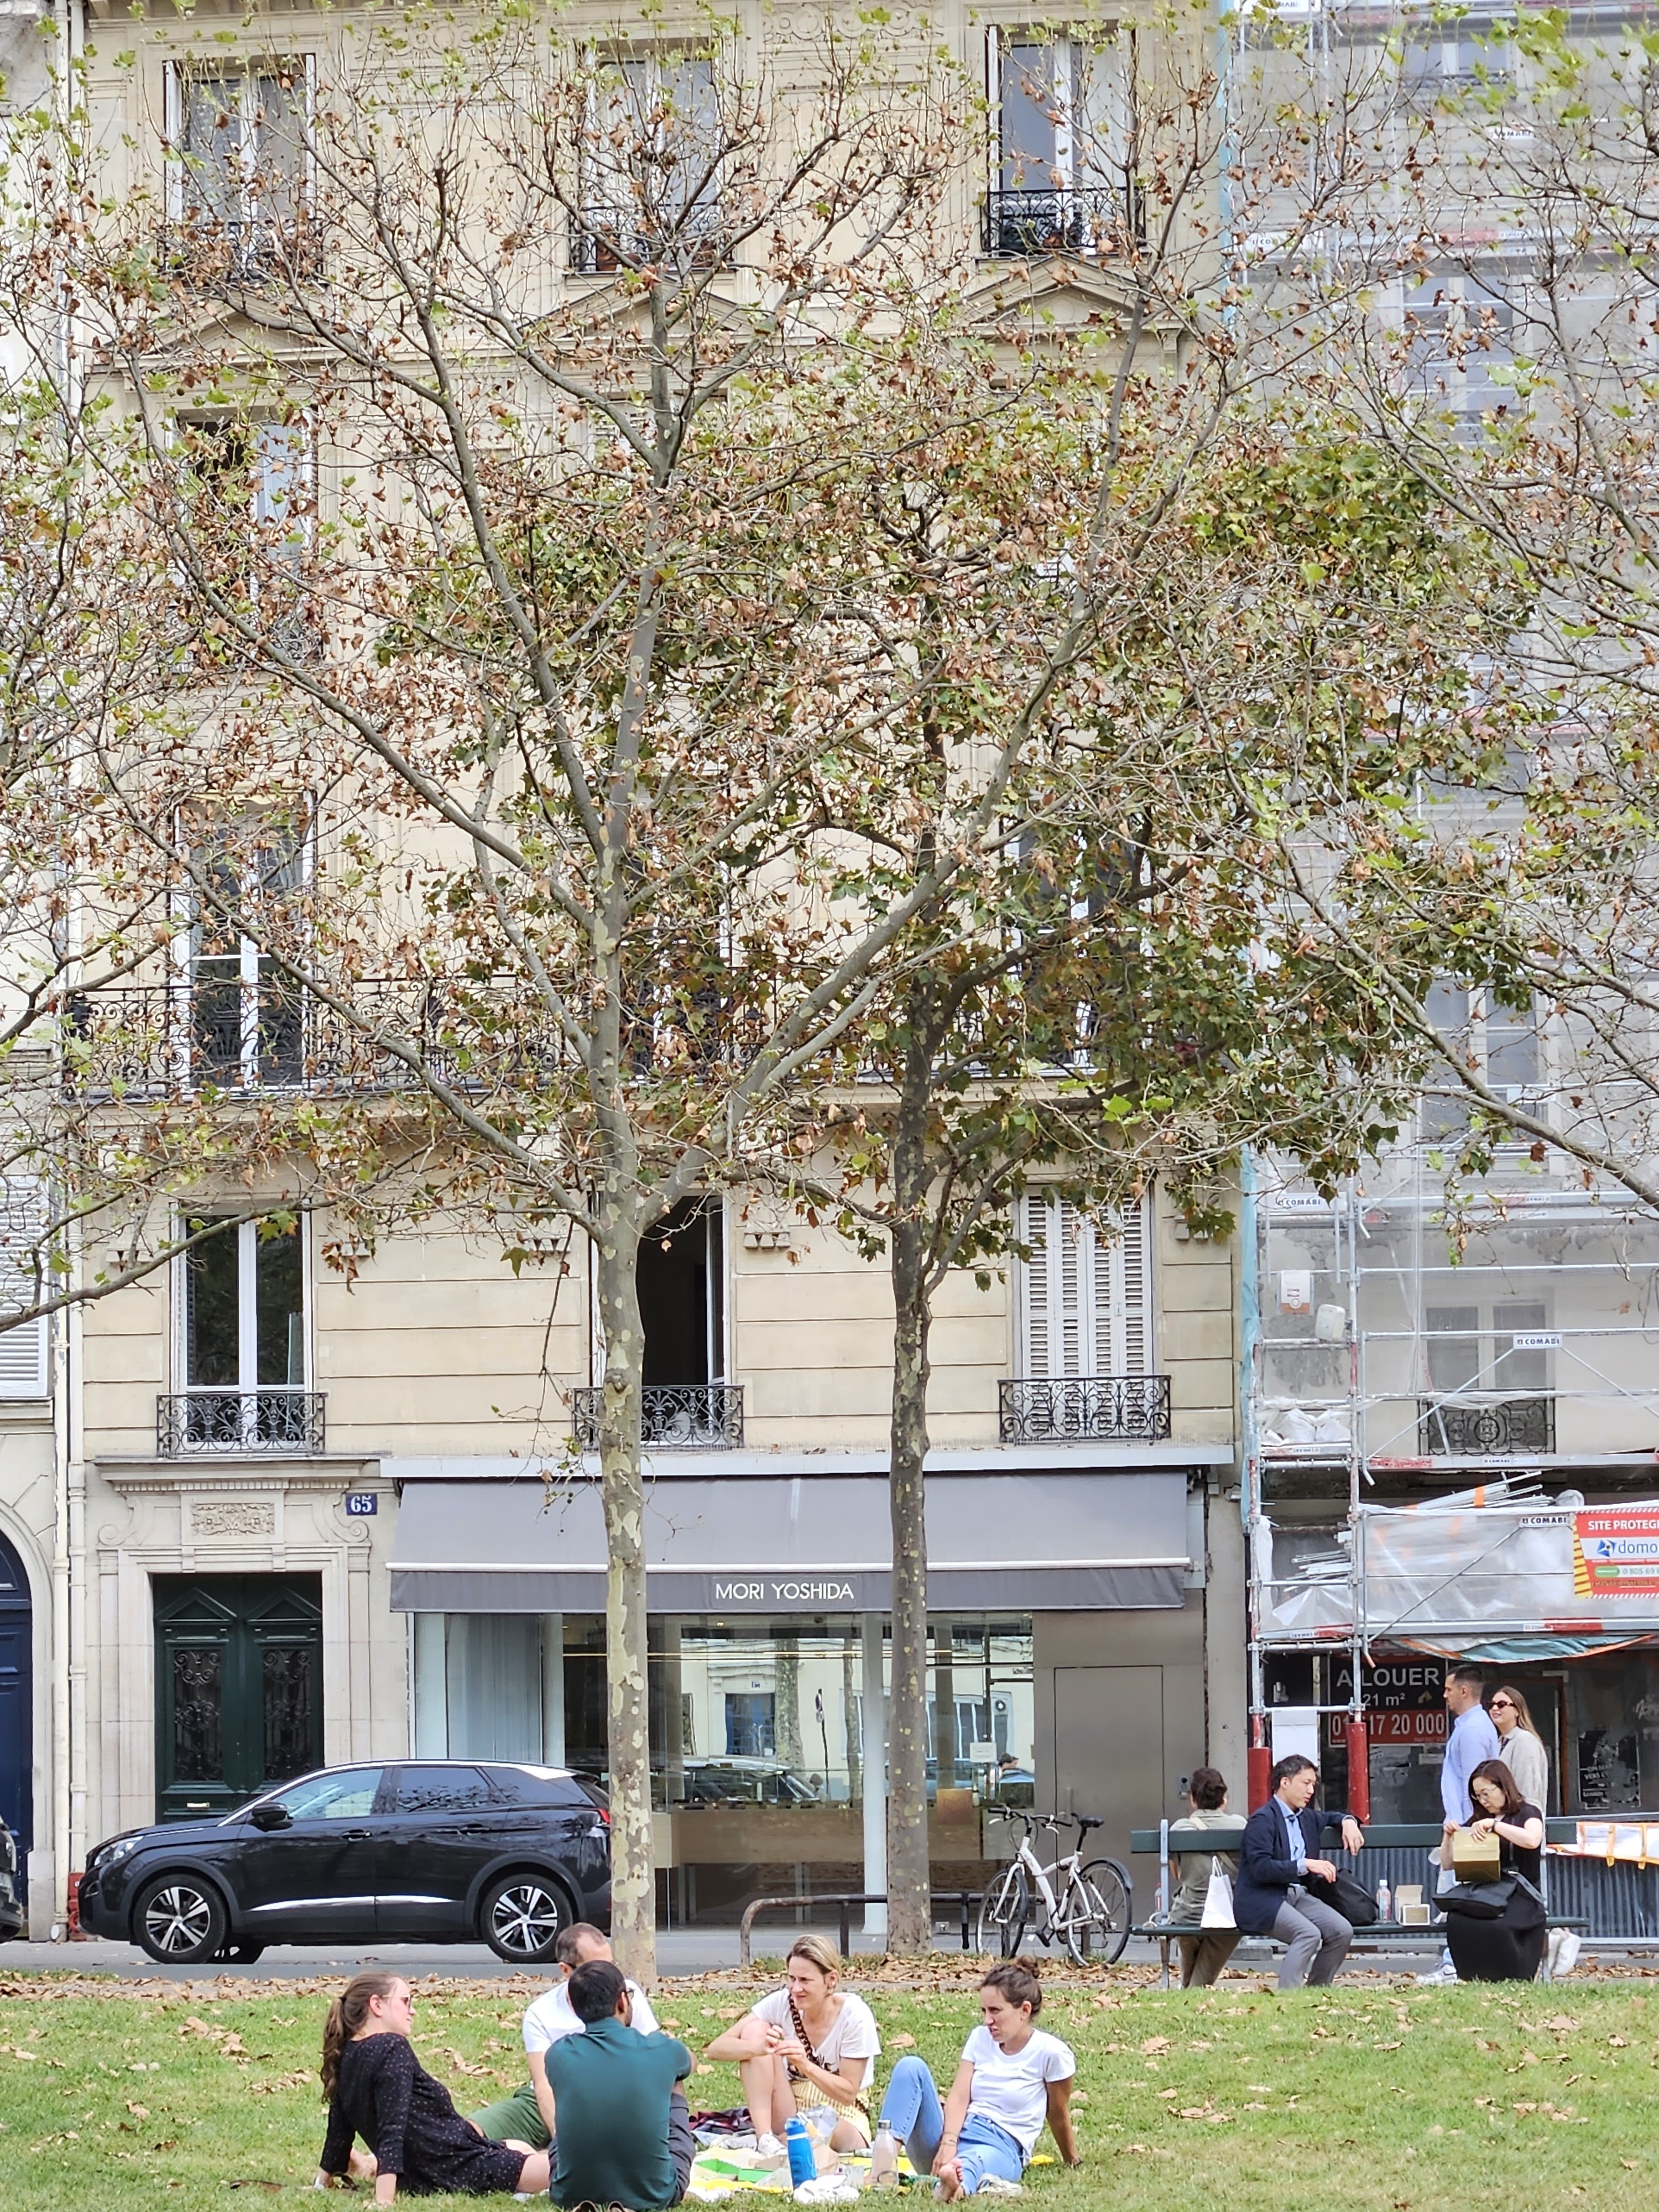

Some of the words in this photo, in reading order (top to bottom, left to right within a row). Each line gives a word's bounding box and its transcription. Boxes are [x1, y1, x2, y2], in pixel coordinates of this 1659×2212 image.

[351, 1495, 372, 1513] 65
[1588, 1520, 1612, 1530] SITE
[1618, 1540, 1659, 1553] domo
[716, 1583, 764, 1600] MORI
[771, 1583, 854, 1599] YOSHIDA
[1337, 1669, 1353, 1687] A
[1361, 1667, 1439, 1687] LOUER
[1391, 1715, 1410, 1735] 20
[1416, 1714, 1445, 1734] 000
